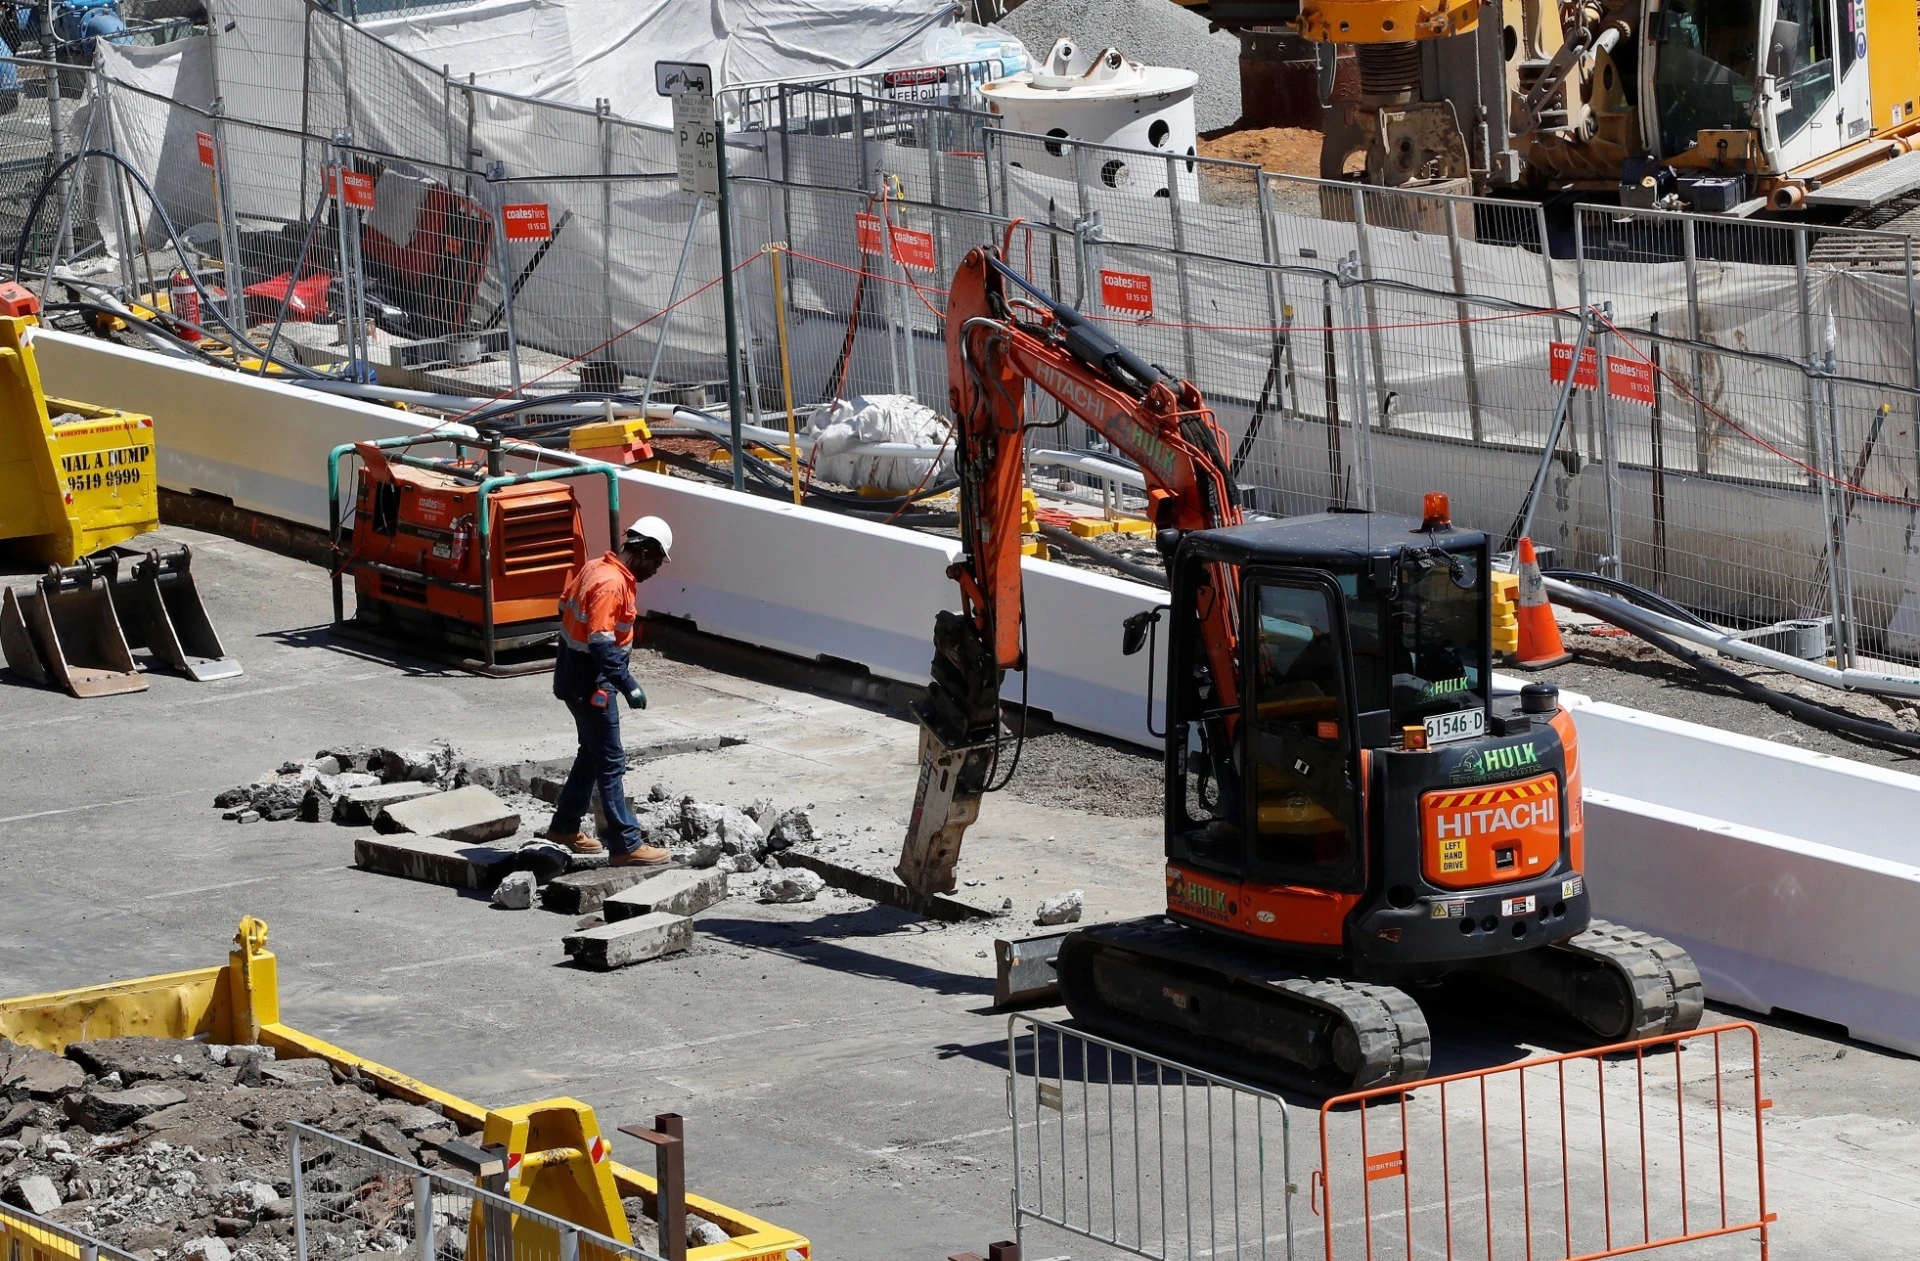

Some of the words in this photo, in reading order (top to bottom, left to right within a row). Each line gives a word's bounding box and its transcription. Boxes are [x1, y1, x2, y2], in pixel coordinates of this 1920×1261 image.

[894, 69, 937, 82] DANGER
[680, 130, 688, 147] P
[696, 131, 714, 149] 4P
[1104, 275, 1148, 291] coateshire
[1126, 293, 1132, 301] 13
[1133, 294, 1140, 302] 15
[1140, 295, 1148, 303] 52
[1553, 347, 1597, 365] coatshire
[1610, 361, 1649, 381] coateshire
[1036, 361, 1106, 420] HITACHI
[94, 452, 103, 468] A
[108, 445, 149, 467] DUMP
[1131, 422, 1177, 474] HULK
[67, 473, 102, 491] 9519
[105, 467, 140, 487] 9999
[1435, 677, 1468, 694] HULK
[1484, 742, 1538, 771] HULK
[1437, 797, 1554, 839] HITACHI
[1444, 841, 1461, 851] LEFT
[1444, 850, 1463, 861] HAND
[1443, 860, 1464, 871] DRIVE
[1188, 882, 1226, 912] HULK
